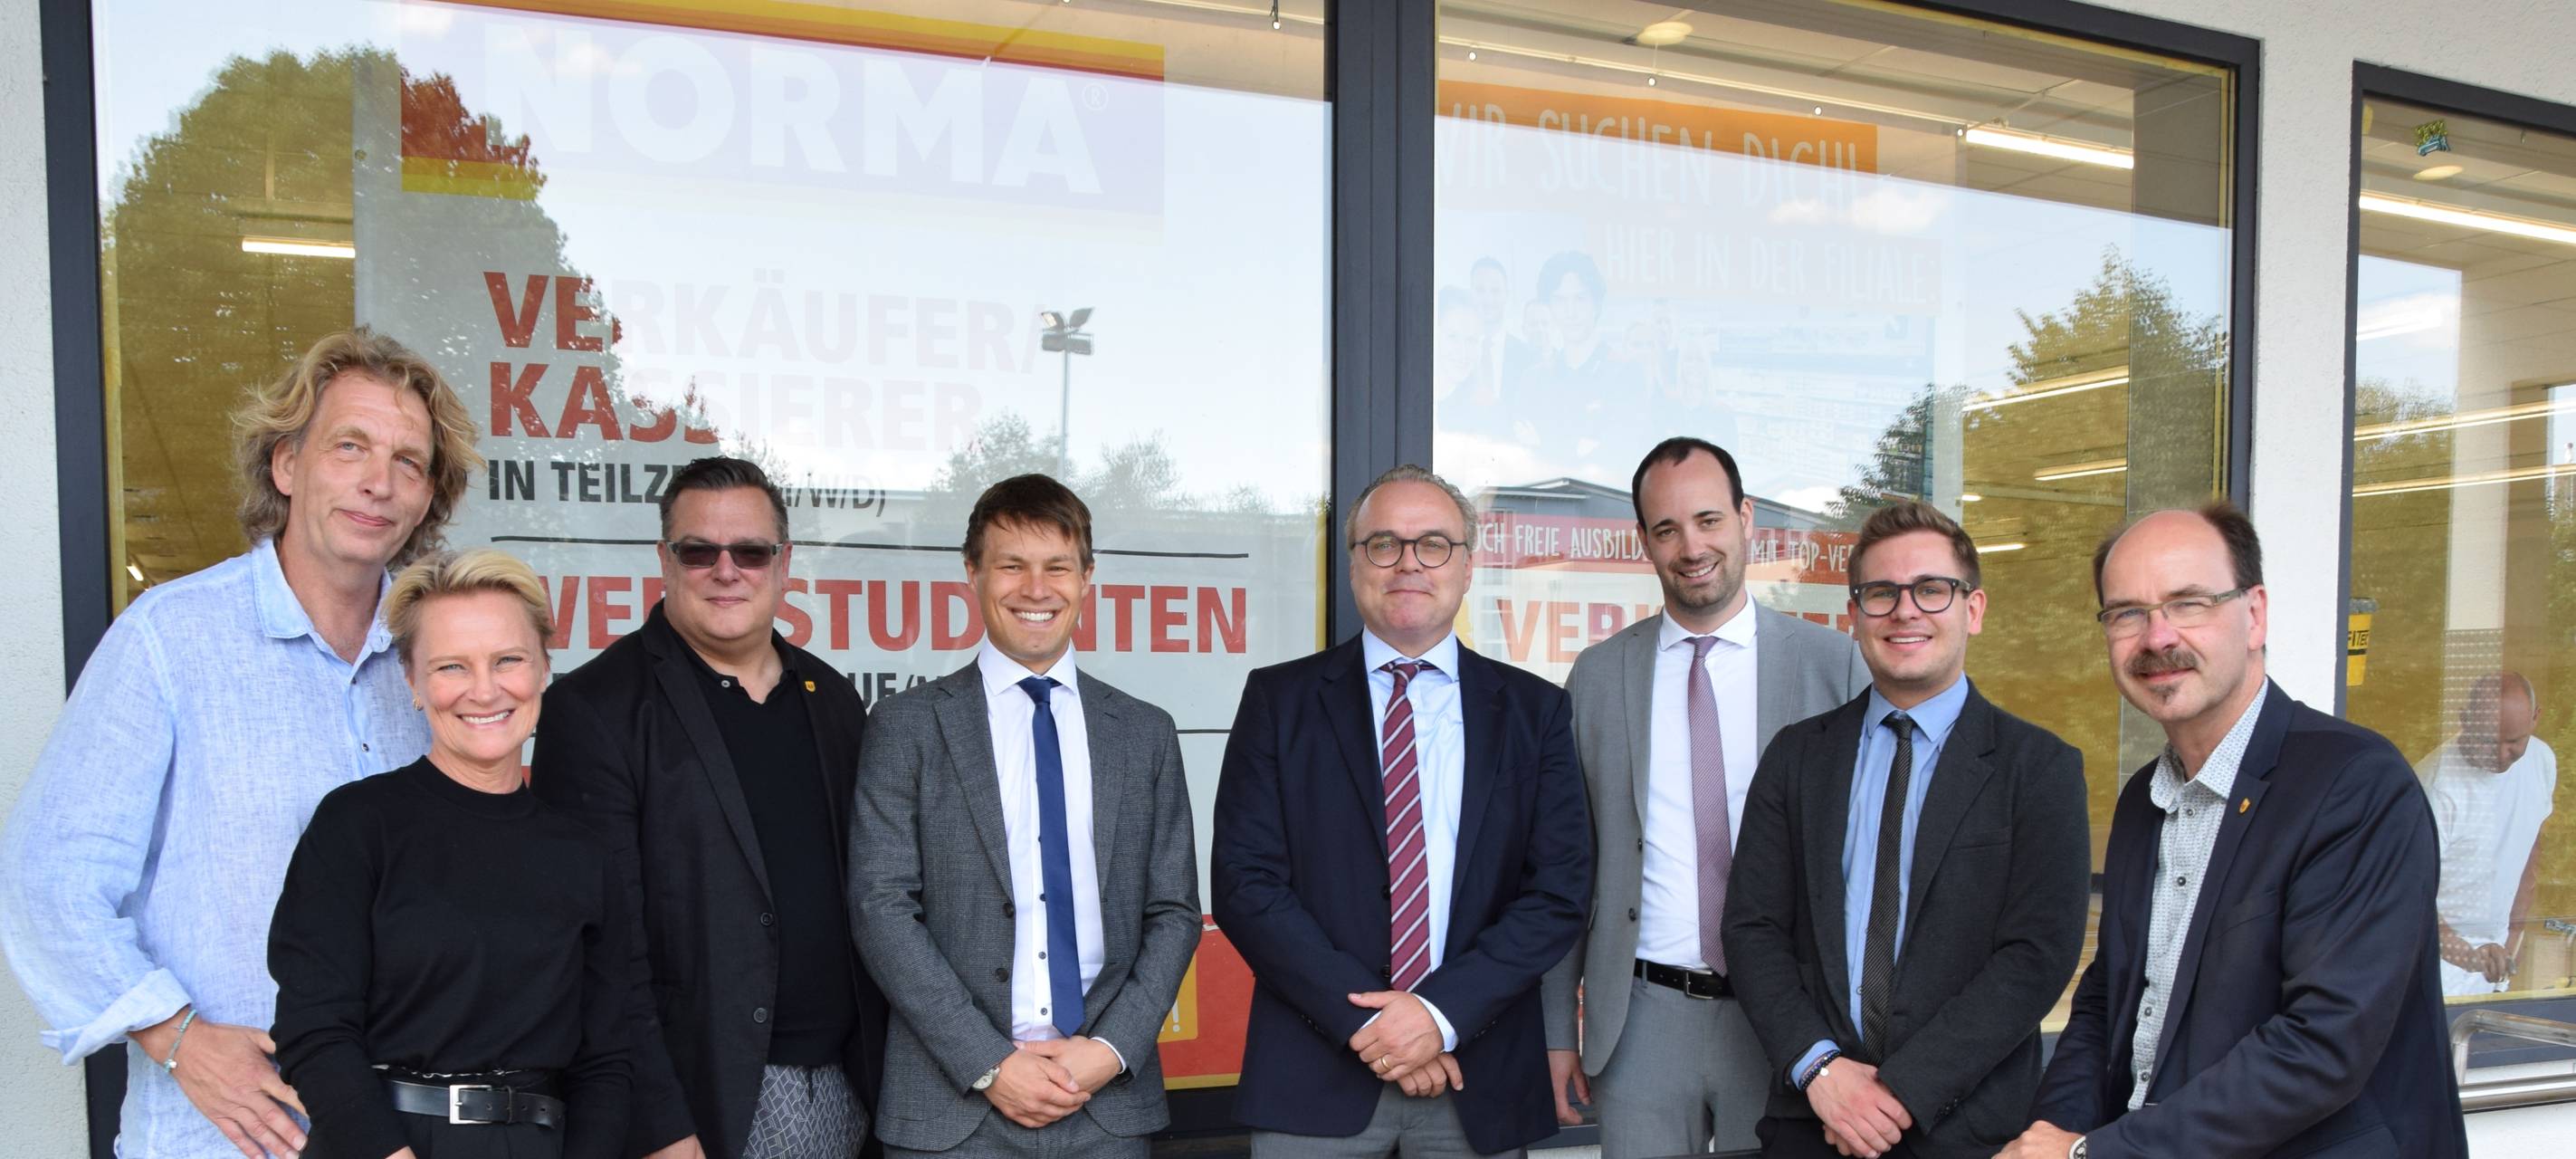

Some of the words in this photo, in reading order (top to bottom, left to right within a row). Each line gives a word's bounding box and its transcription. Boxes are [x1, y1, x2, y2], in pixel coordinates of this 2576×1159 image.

[484, 22, 1102, 194] NORMA
[1539, 109, 1713, 206] SUCHEN
[1605, 217, 1676, 283] HIER
[1693, 231, 1731, 291] IN
[1750, 235, 1808, 296] DER
[489, 460, 536, 501] IN
[550, 461, 686, 503] TEILZ
[1514, 524, 1561, 557] FREIE
[1570, 527, 1646, 560] AUSBILD
[1751, 539, 1779, 567] MIT
